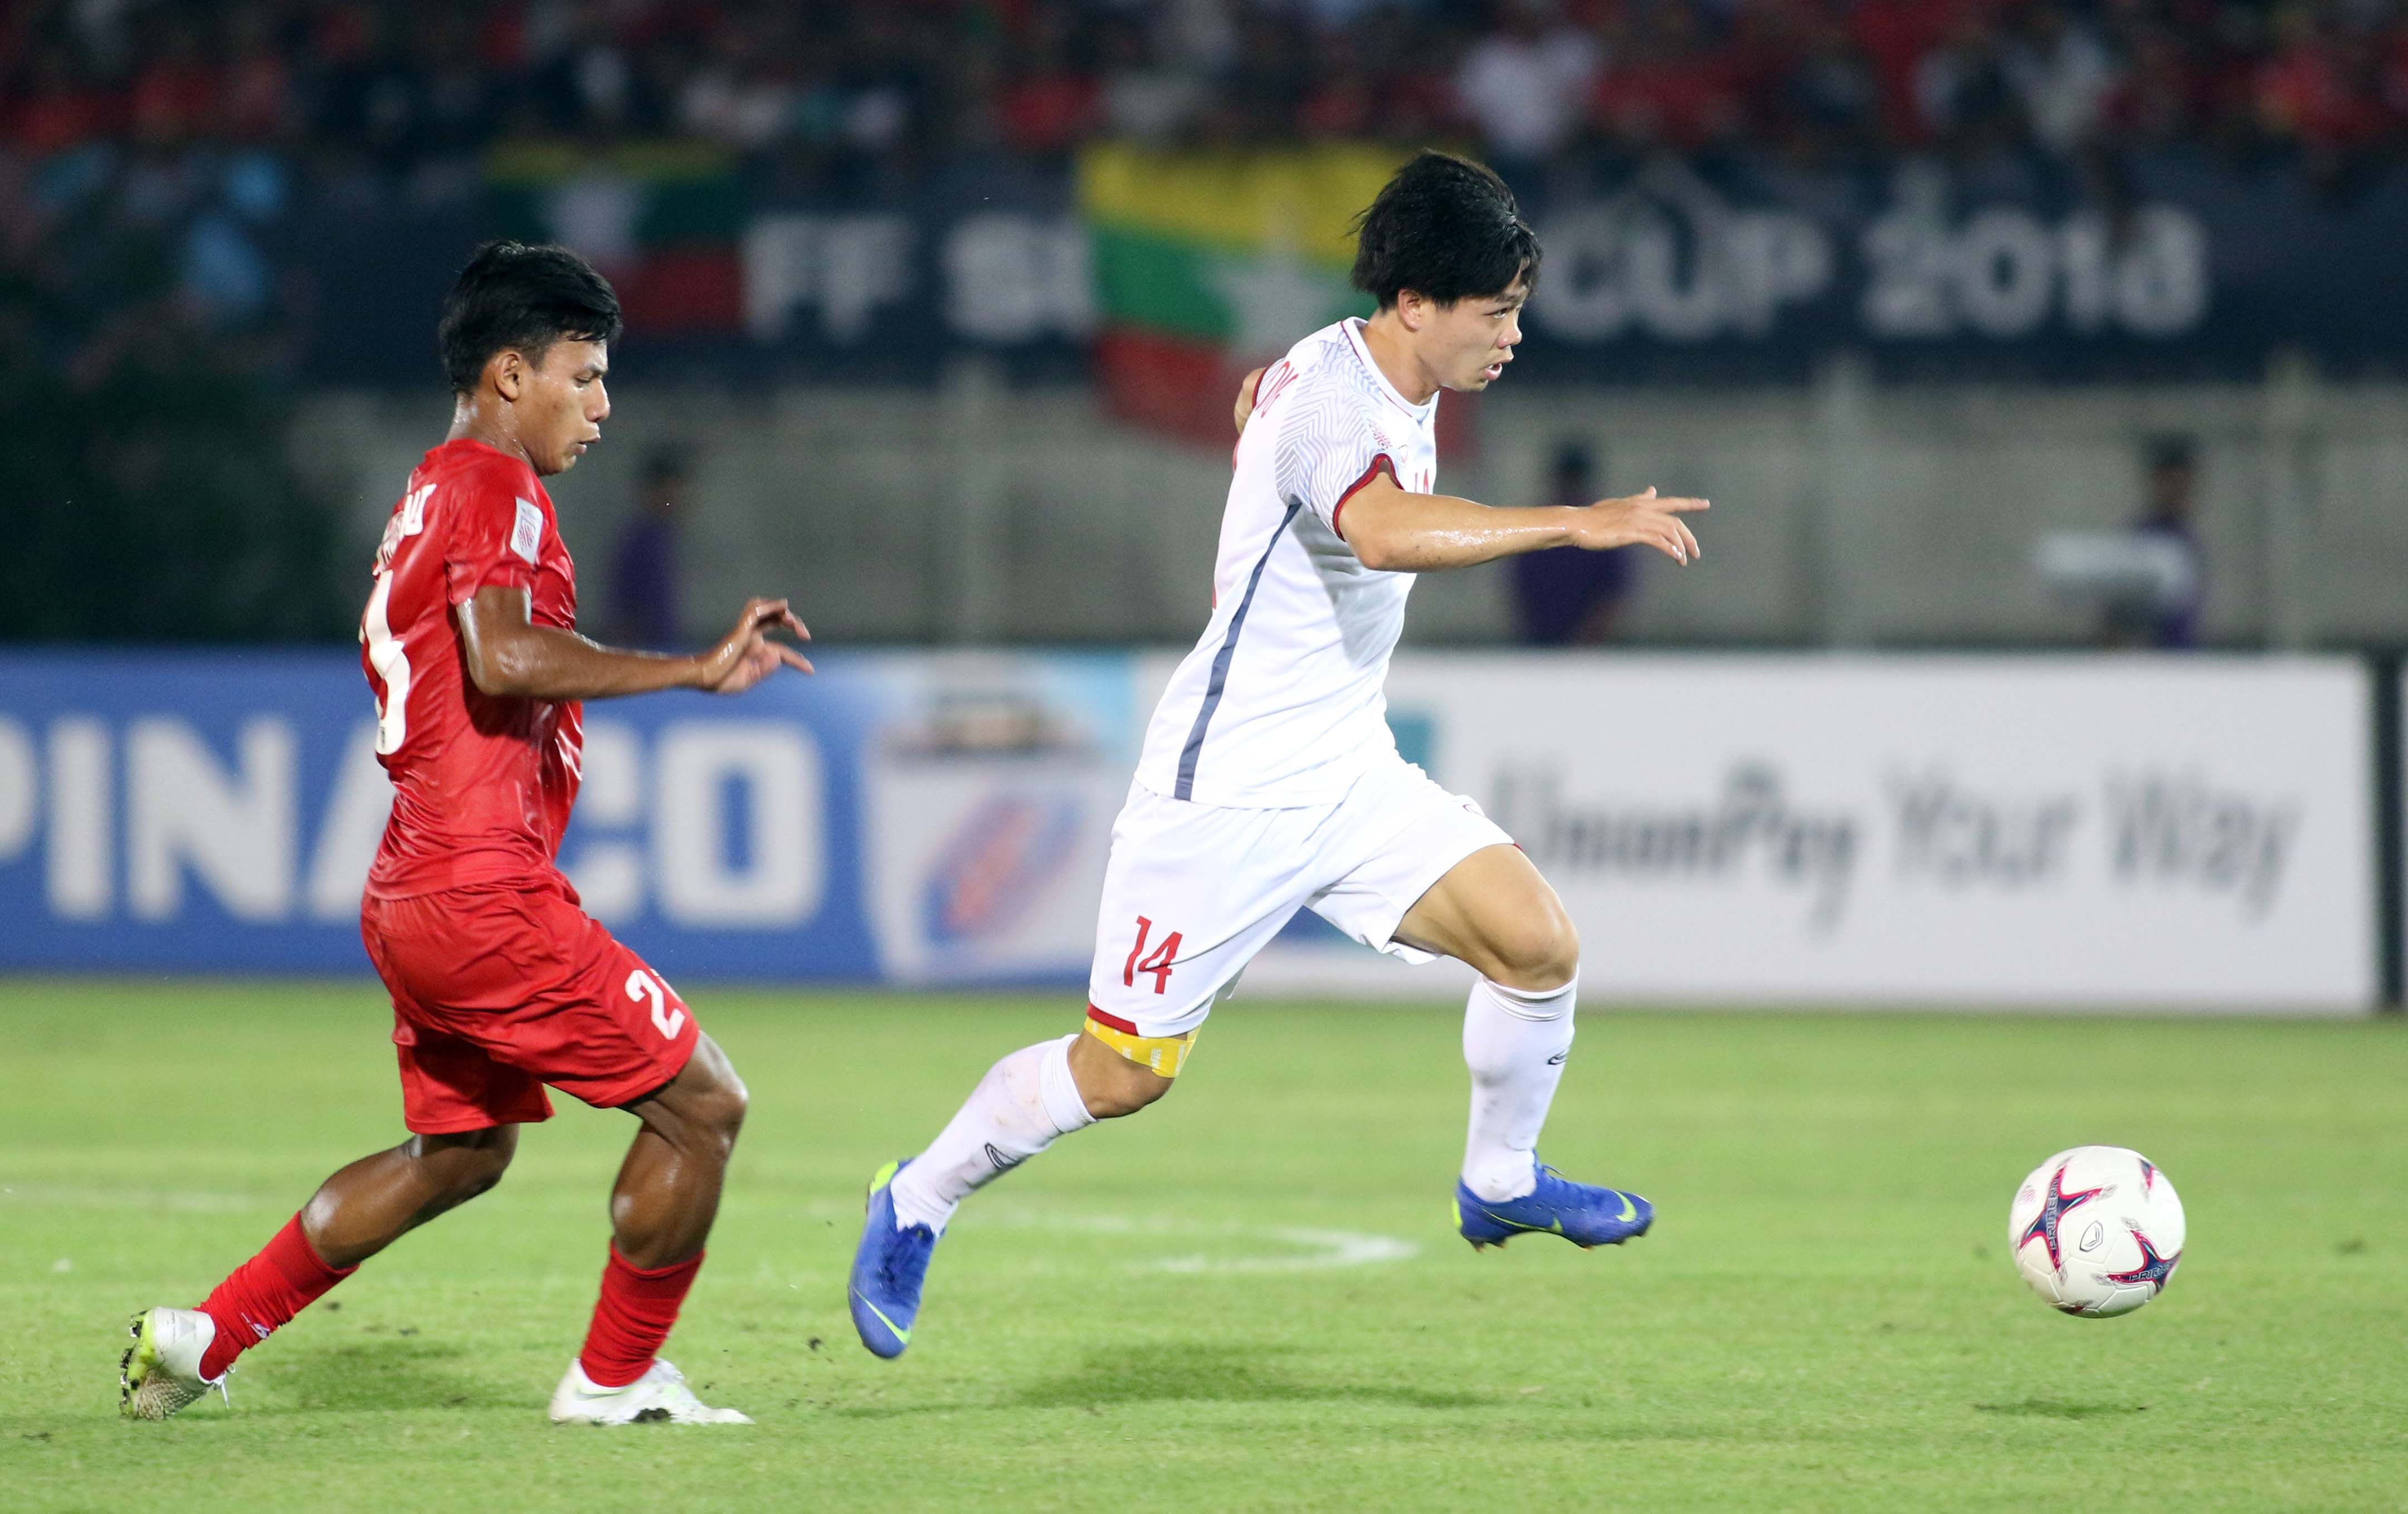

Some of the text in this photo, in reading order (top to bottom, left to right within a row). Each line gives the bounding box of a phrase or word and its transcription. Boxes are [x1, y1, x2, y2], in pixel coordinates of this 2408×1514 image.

[744, 213, 909, 339] FF
[1537, 209, 1833, 339] CUP
[1862, 209, 2213, 339] 2018
[0, 713, 830, 929] INO
[624, 968, 686, 1041] 2
[1124, 915, 1183, 994] 14
